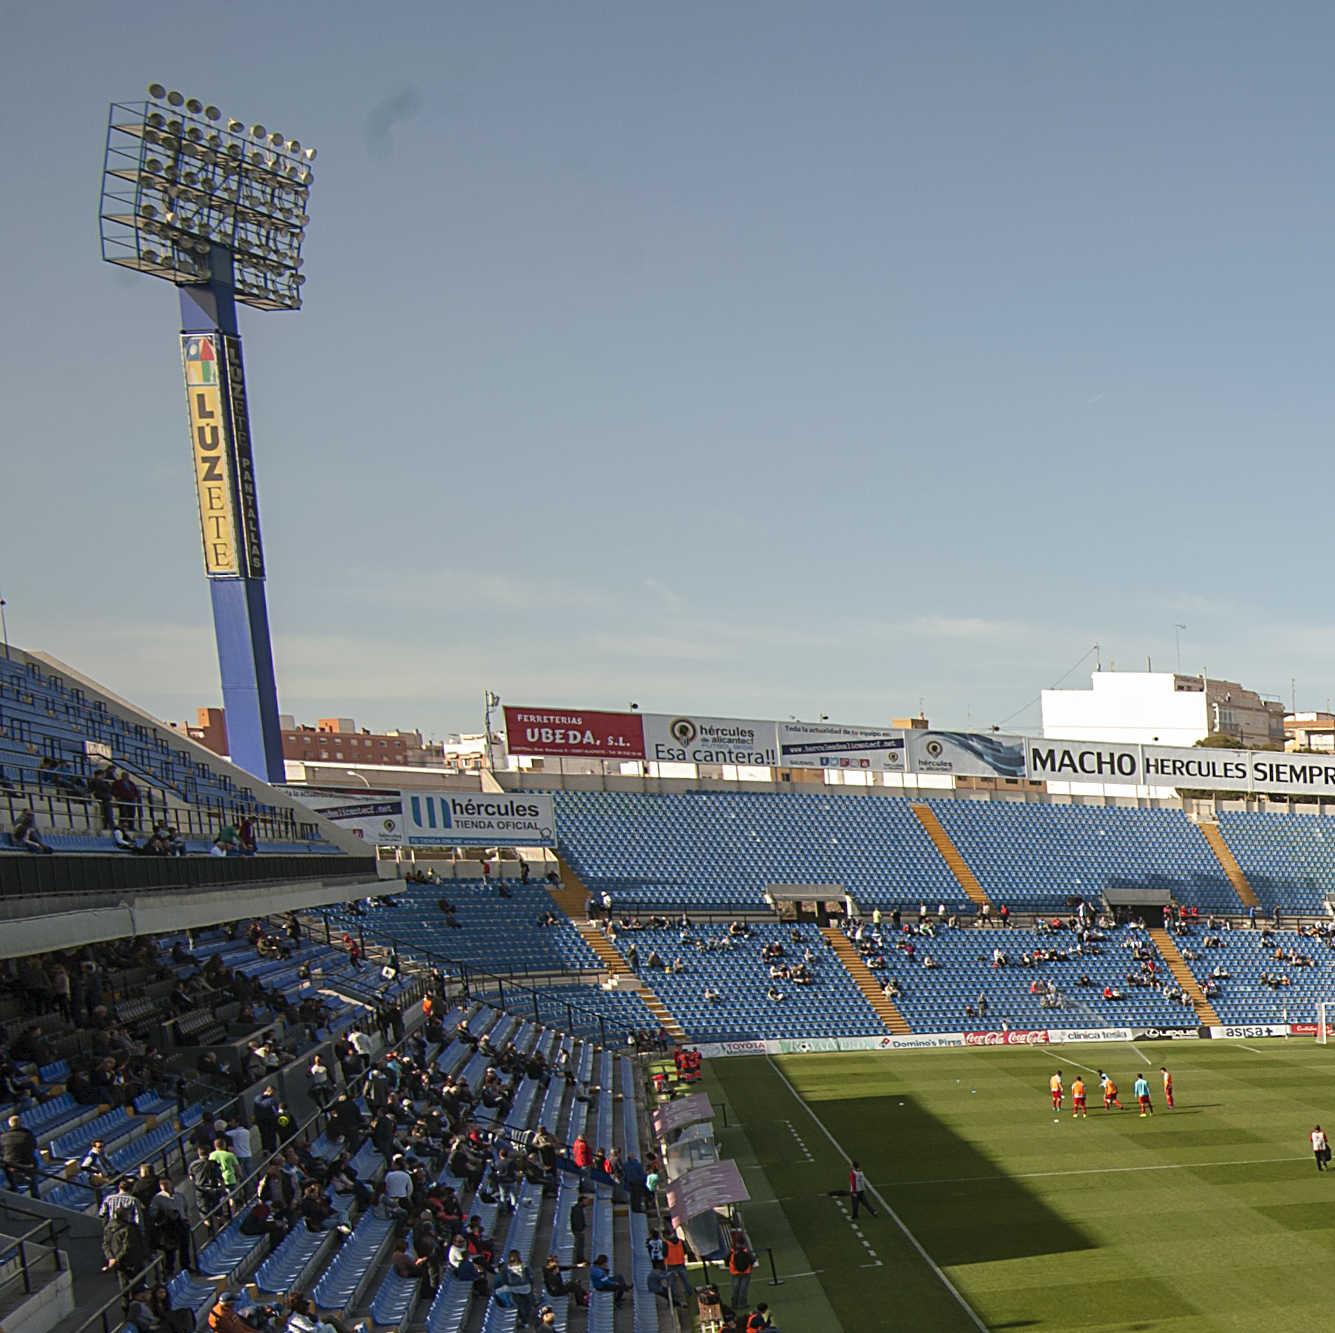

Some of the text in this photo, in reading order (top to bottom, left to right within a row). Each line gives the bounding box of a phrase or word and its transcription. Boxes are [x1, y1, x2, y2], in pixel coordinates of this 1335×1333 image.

[517, 714, 583, 725] FERRETERIAS
[655, 743, 687, 761] Esa
[693, 747, 776, 765] cantera!!
[1031, 747, 1137, 777] MACHO
[1145, 757, 1248, 780] HERCULES
[452, 798, 540, 817] hércules
[454, 819, 540, 831] TIENDA OFICIAL
[1226, 1027, 1263, 1038] asisa
[727, 1042, 765, 1050] TOYOTA
